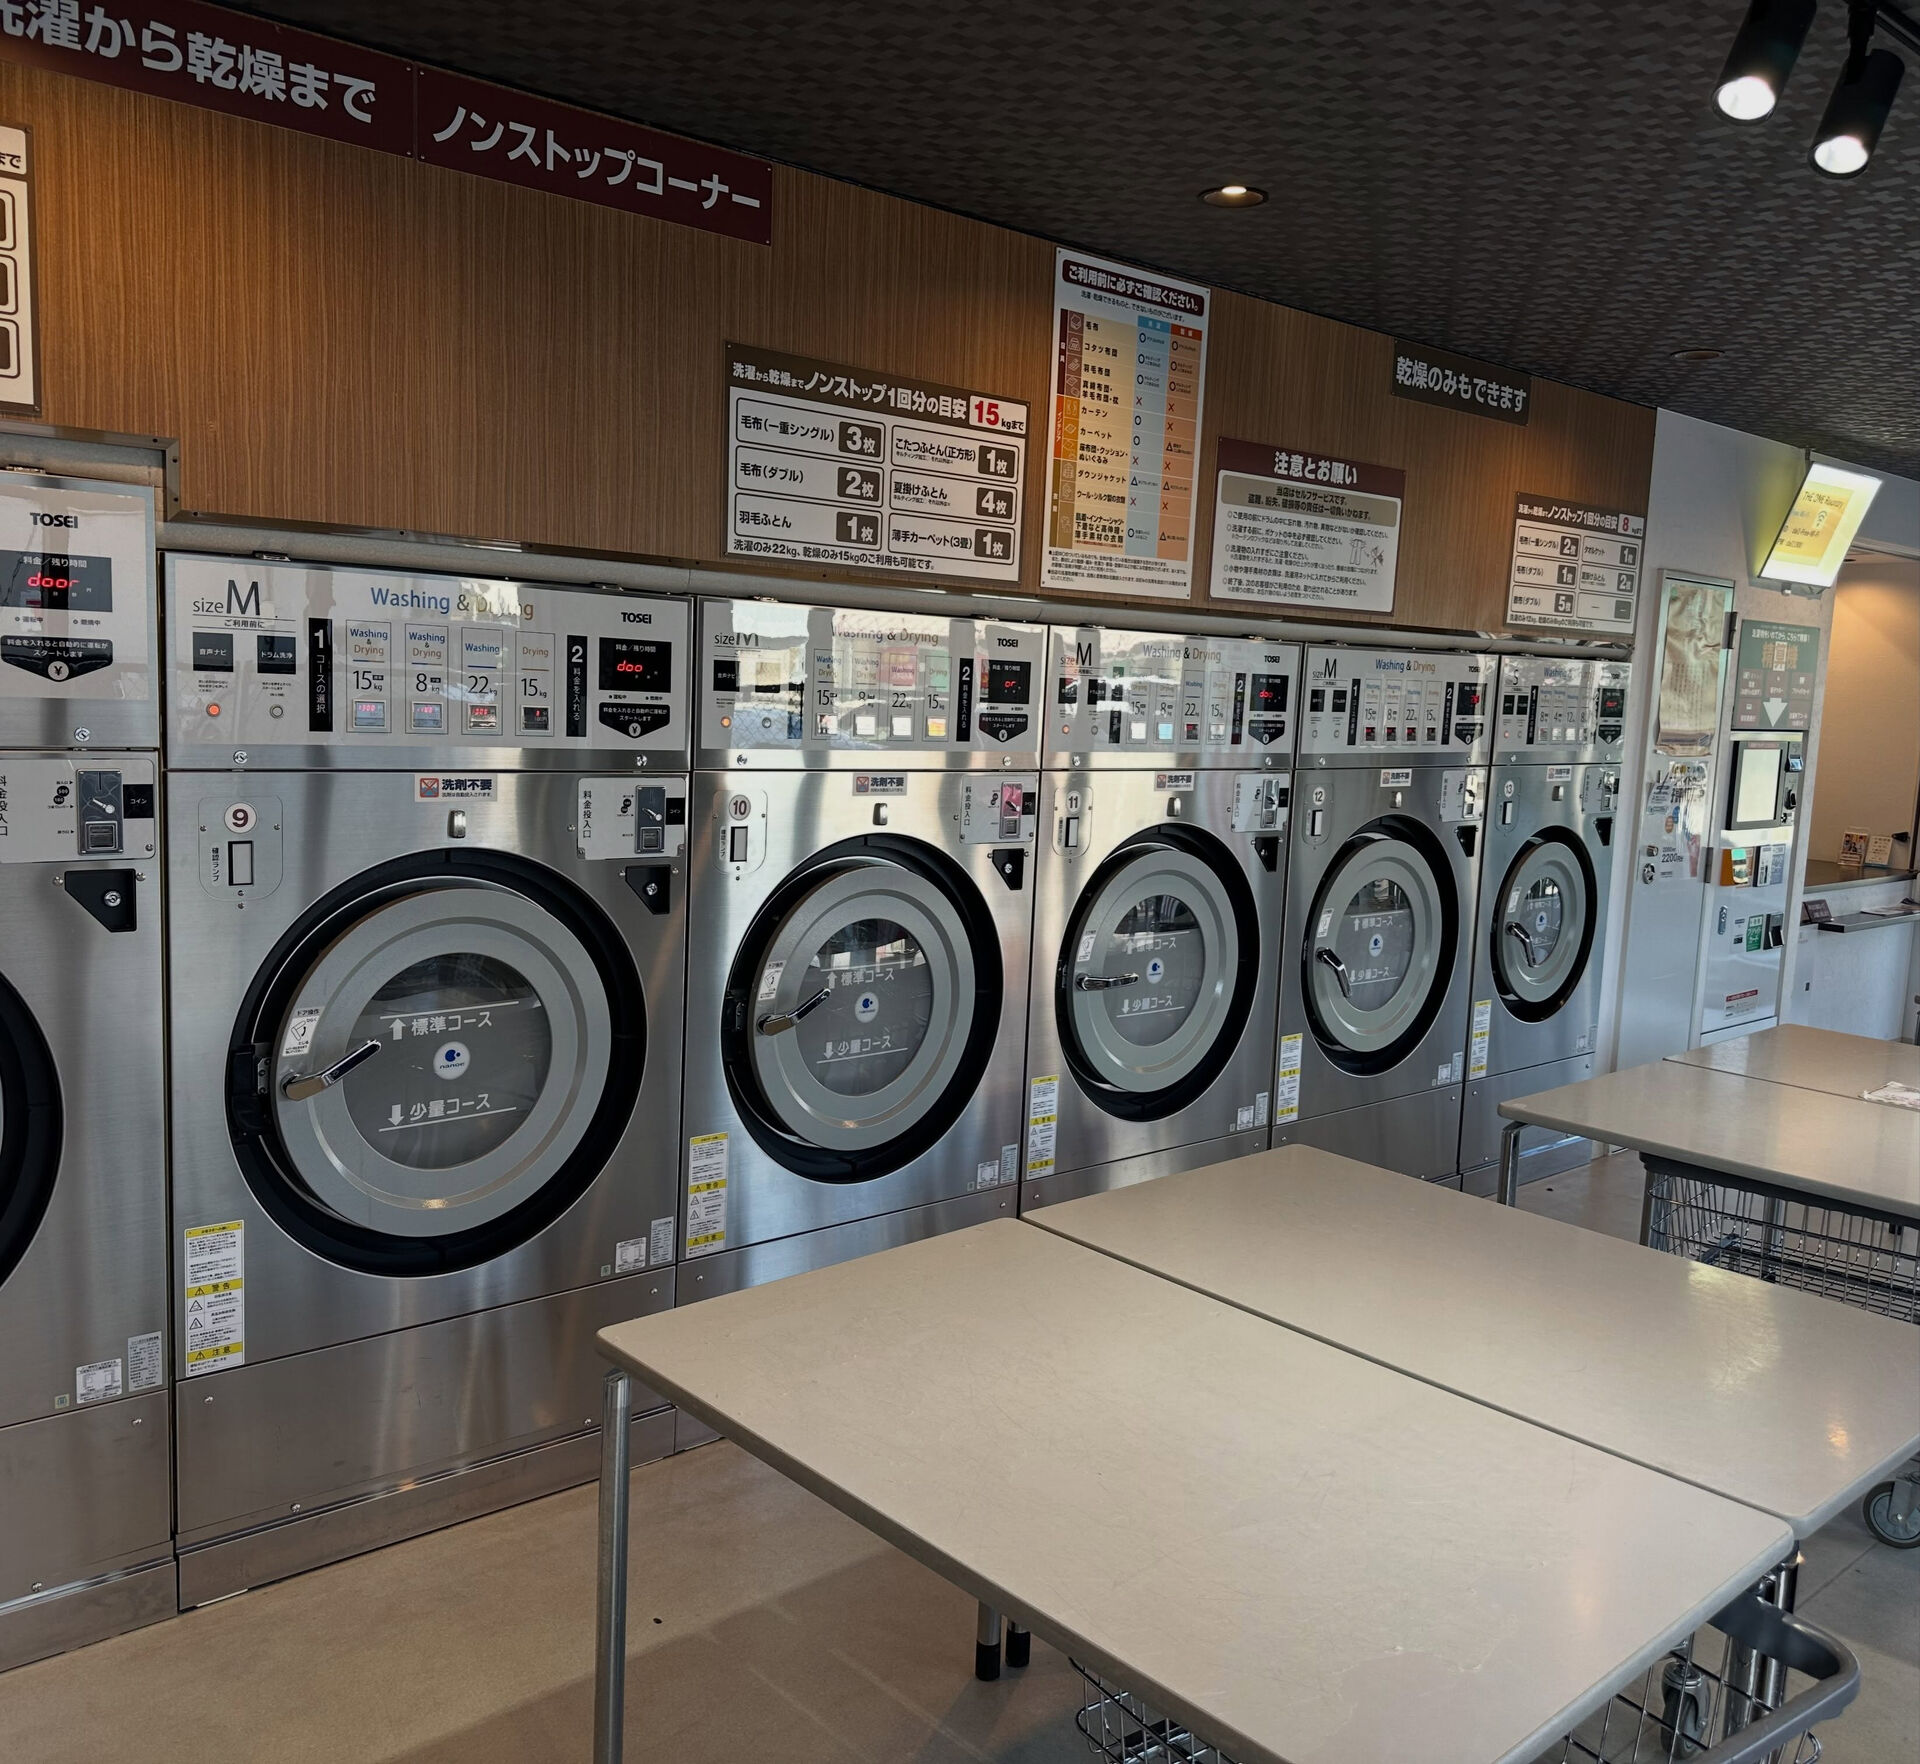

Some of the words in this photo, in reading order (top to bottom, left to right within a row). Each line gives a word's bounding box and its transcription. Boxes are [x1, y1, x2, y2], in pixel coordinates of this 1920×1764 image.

[433, 104, 761, 211] ノンストップコーナー
[1069, 264, 1199, 312] ご利用前に必ずご確認ください。
[1086, 321, 1099, 332] 毛布
[1084, 342, 1118, 357] コタツ布団
[1083, 363, 1111, 377] 羽毛布団
[732, 362, 967, 420] 洗濯から乾燥までノンストップ1回分の目安
[1396, 356, 1527, 413] 乾燥のみもできます
[1081, 406, 1108, 417] カーテン
[741, 415, 835, 443] 毛布(一重シングル)
[1080, 427, 1112, 440] カーペット
[895, 438, 976, 462] こたつふとん(正方形)
[1079, 453, 1108, 465] ぬいぐるみ
[740, 463, 804, 483] 毛布(ダブル)
[1273, 451, 1358, 485] 注意とお願い
[1077, 470, 1127, 485] ダウンジャケット
[893, 481, 948, 500] 夏掛けふとん
[1276, 486, 1348, 506] 当店はセルフサービスです。
[29, 512, 79, 529] TOSEI
[739, 510, 792, 529] 羽毛ふとん
[27, 572, 80, 589] door
[192, 597, 224, 614] size
[225, 580, 261, 616] M
[371, 587, 450, 614] Washing
[456, 594, 470, 612] &
[224, 618, 265, 629] ご利用前に
[621, 611, 652, 625] TOSEI
[313, 629, 324, 649] 1
[350, 628, 389, 641] Washing
[408, 631, 446, 645] Washing
[714, 632, 735, 646] size
[887, 631, 896, 641] &
[900, 628, 939, 646] Drying
[6, 638, 109, 650] 料金を入れると自動的に運転が
[353, 644, 385, 656] Drying
[465, 643, 500, 655] Washing
[997, 637, 1019, 648] TOSEI
[33, 650, 84, 659] スタートします
[199, 647, 227, 657] 音声ナビ
[412, 647, 442, 659] Drying
[522, 646, 549, 658] Drying
[571, 645, 583, 664] 2
[1076, 642, 1093, 667] M
[1143, 644, 1181, 661] Washing
[1183, 647, 1191, 659] &
[1192, 648, 1222, 664] Drying
[1264, 654, 1281, 664] TOSEI
[816, 655, 842, 665] Washing
[1375, 658, 1405, 673] Washing
[1413, 661, 1436, 675] Drying
[891, 665, 915, 675] Washing
[962, 666, 970, 681] 2
[1324, 657, 1338, 679] M
[315, 654, 327, 714] コースの選択
[352, 670, 373, 691] 15
[373, 682, 383, 692] kg
[415, 673, 427, 693] 8
[431, 684, 440, 694] kg
[467, 675, 490, 694] 22
[489, 686, 498, 696] kg
[521, 678, 538, 697] 15
[539, 689, 547, 698] kg
[1185, 680, 1203, 689] Washing
[1237, 679, 1244, 693] 2
[573, 667, 582, 721] 料金を入れる
[816, 689, 830, 705] 15
[1353, 684, 1359, 697] 1
[1446, 687, 1452, 699] 2
[891, 692, 907, 708] 22
[927, 694, 939, 709] 15
[603, 705, 668, 716] 料金を入れると自動的に運転が
[1131, 701, 1141, 715] 15
[1184, 702, 1196, 717] 22
[1211, 703, 1220, 718] 15
[1365, 708, 1373, 721] 15
[1405, 708, 1415, 721] 22
[1426, 708, 1433, 721] 15
[619, 714, 652, 722] スタートします
[441, 778, 493, 792] 洗剤不要
[870, 776, 905, 788] 洗剤不要
[1505, 783, 1513, 795] 13
[1068, 795, 1079, 809] 11
[1314, 790, 1323, 802] 12
[733, 799, 748, 816] 10
[963, 786, 972, 827] 料金投入口
[231, 808, 249, 828] 9
[583, 790, 592, 839] 料金投入口
[841, 968, 895, 987] 標準コース
[411, 1011, 492, 1037] 標準コース
[837, 1036, 892, 1056] 少量コース
[409, 1093, 491, 1122] 少量コース
